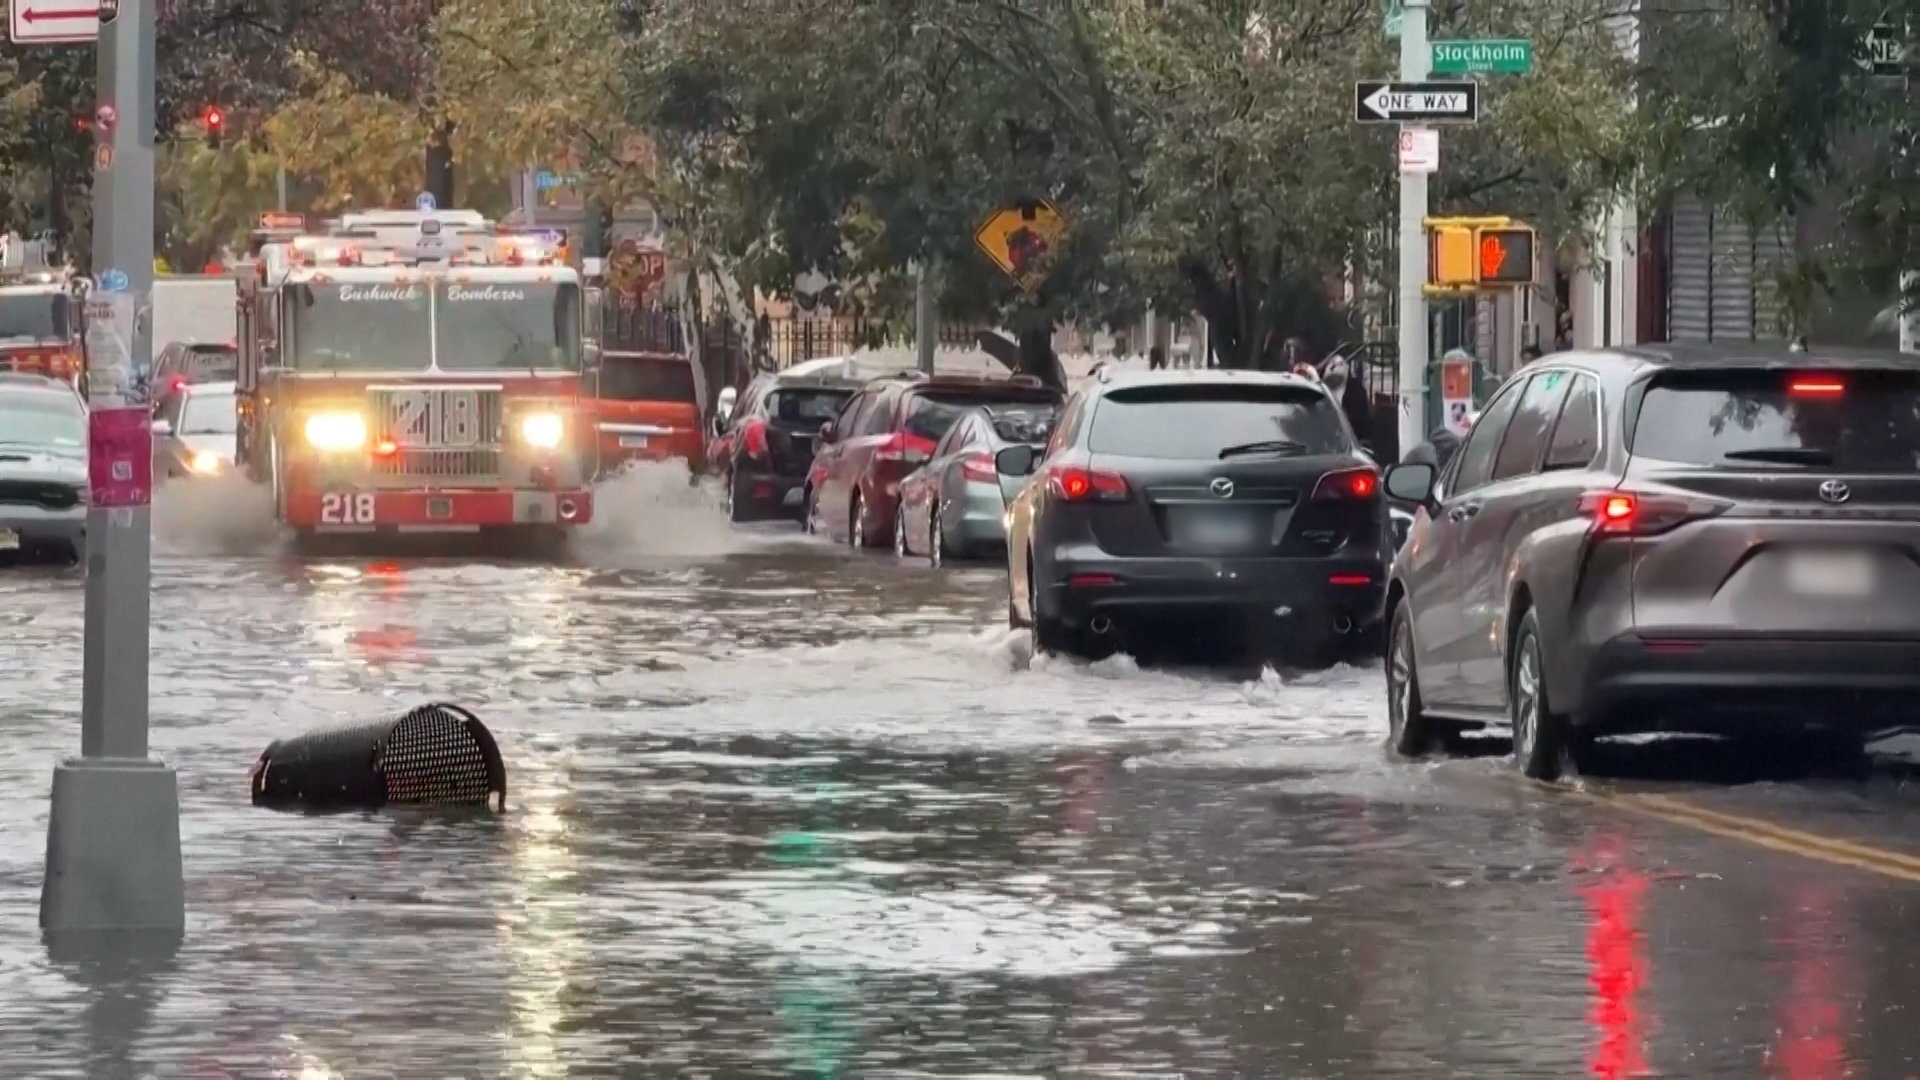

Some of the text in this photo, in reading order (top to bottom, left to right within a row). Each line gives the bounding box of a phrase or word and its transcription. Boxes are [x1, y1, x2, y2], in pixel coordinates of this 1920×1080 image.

[1435, 44, 1525, 61] Stockholm
[1467, 61, 1493, 71] Street
[1378, 95, 1459, 110] ONE WAY
[339, 284, 524, 303] Bushwick Bomberos
[321, 493, 376, 524] 218
